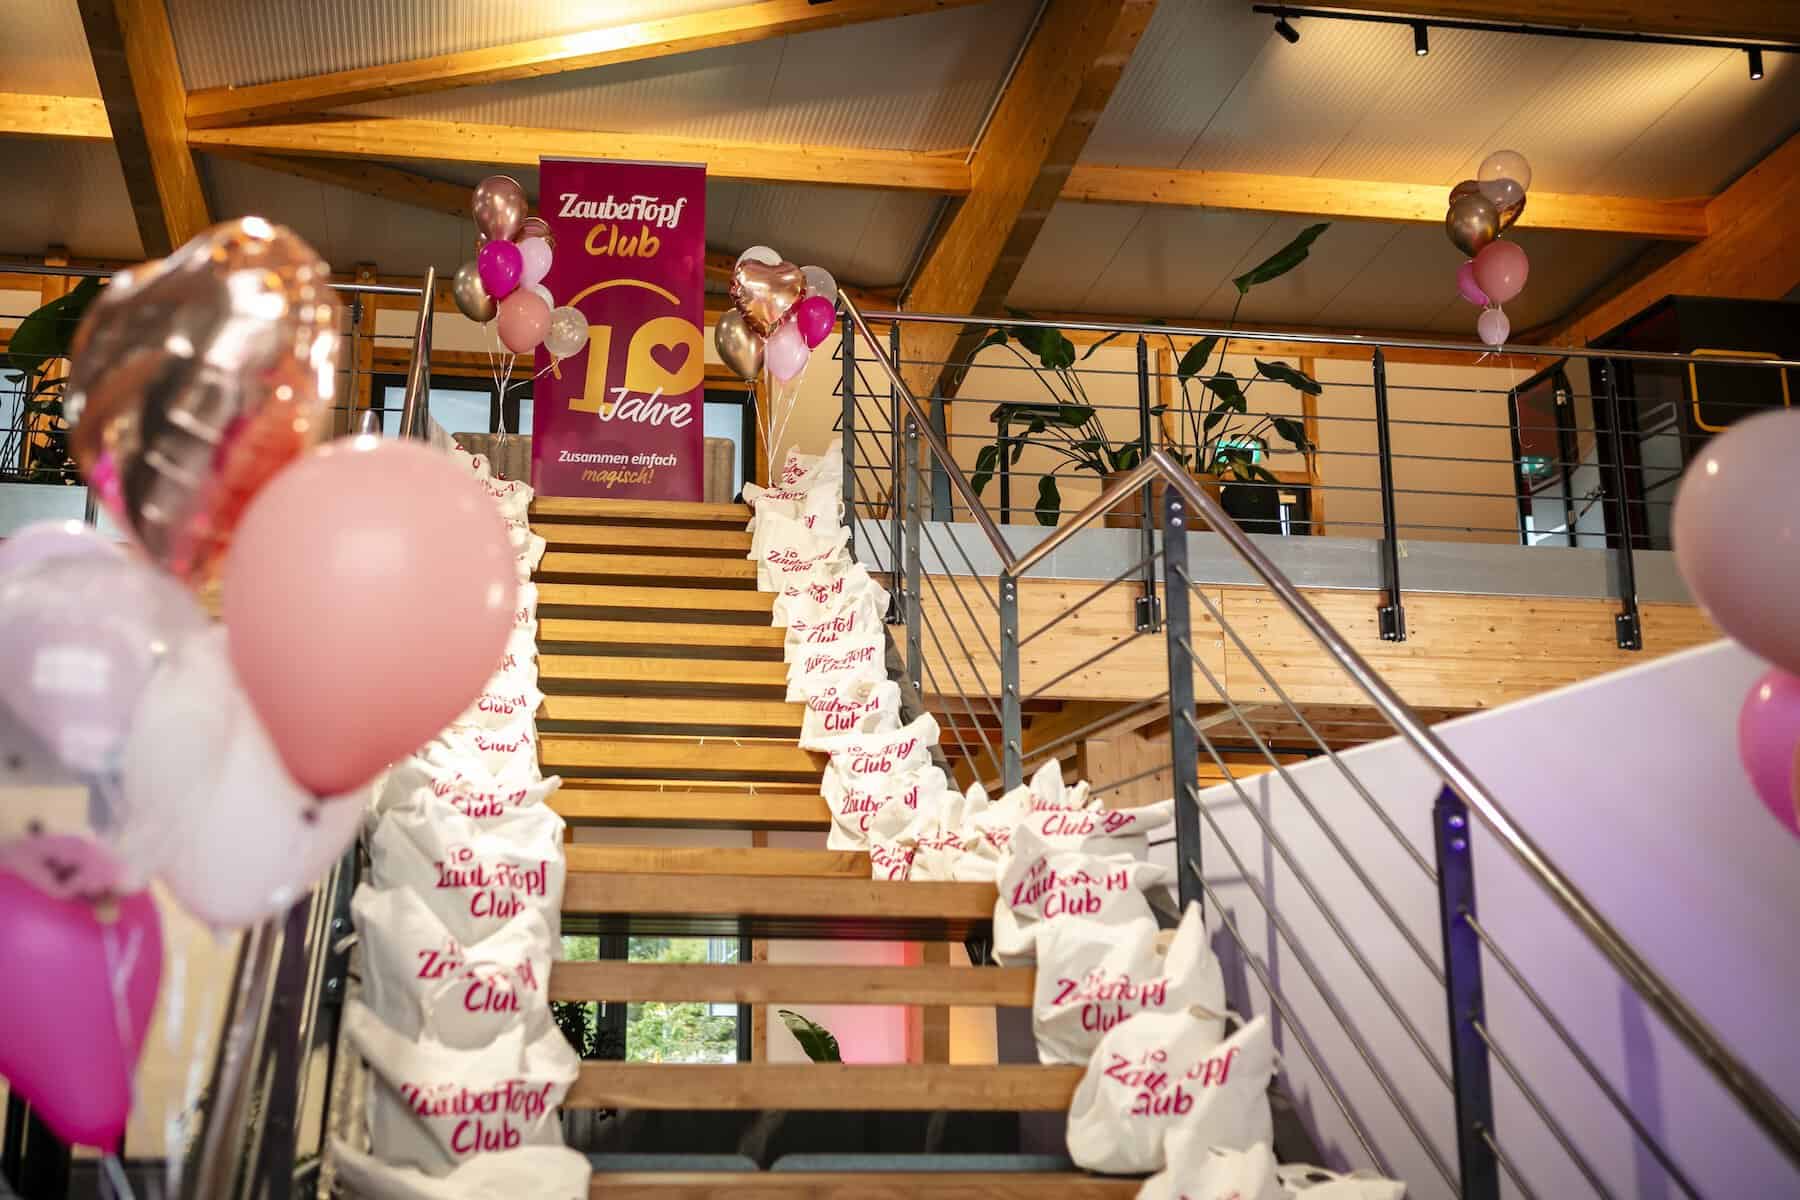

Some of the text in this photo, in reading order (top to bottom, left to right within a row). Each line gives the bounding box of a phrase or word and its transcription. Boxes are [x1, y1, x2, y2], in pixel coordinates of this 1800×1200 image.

[558, 193, 688, 229] ZauberTopf
[585, 223, 660, 258] Club
[599, 387, 693, 428] Jahre
[558, 450, 677, 468] Zusammen einfach
[582, 466, 655, 489] magisch!
[852, 757, 892, 773] Club
[1042, 814, 1095, 836] Club
[1043, 889, 1102, 918] Club
[451, 1117, 521, 1154] Club
